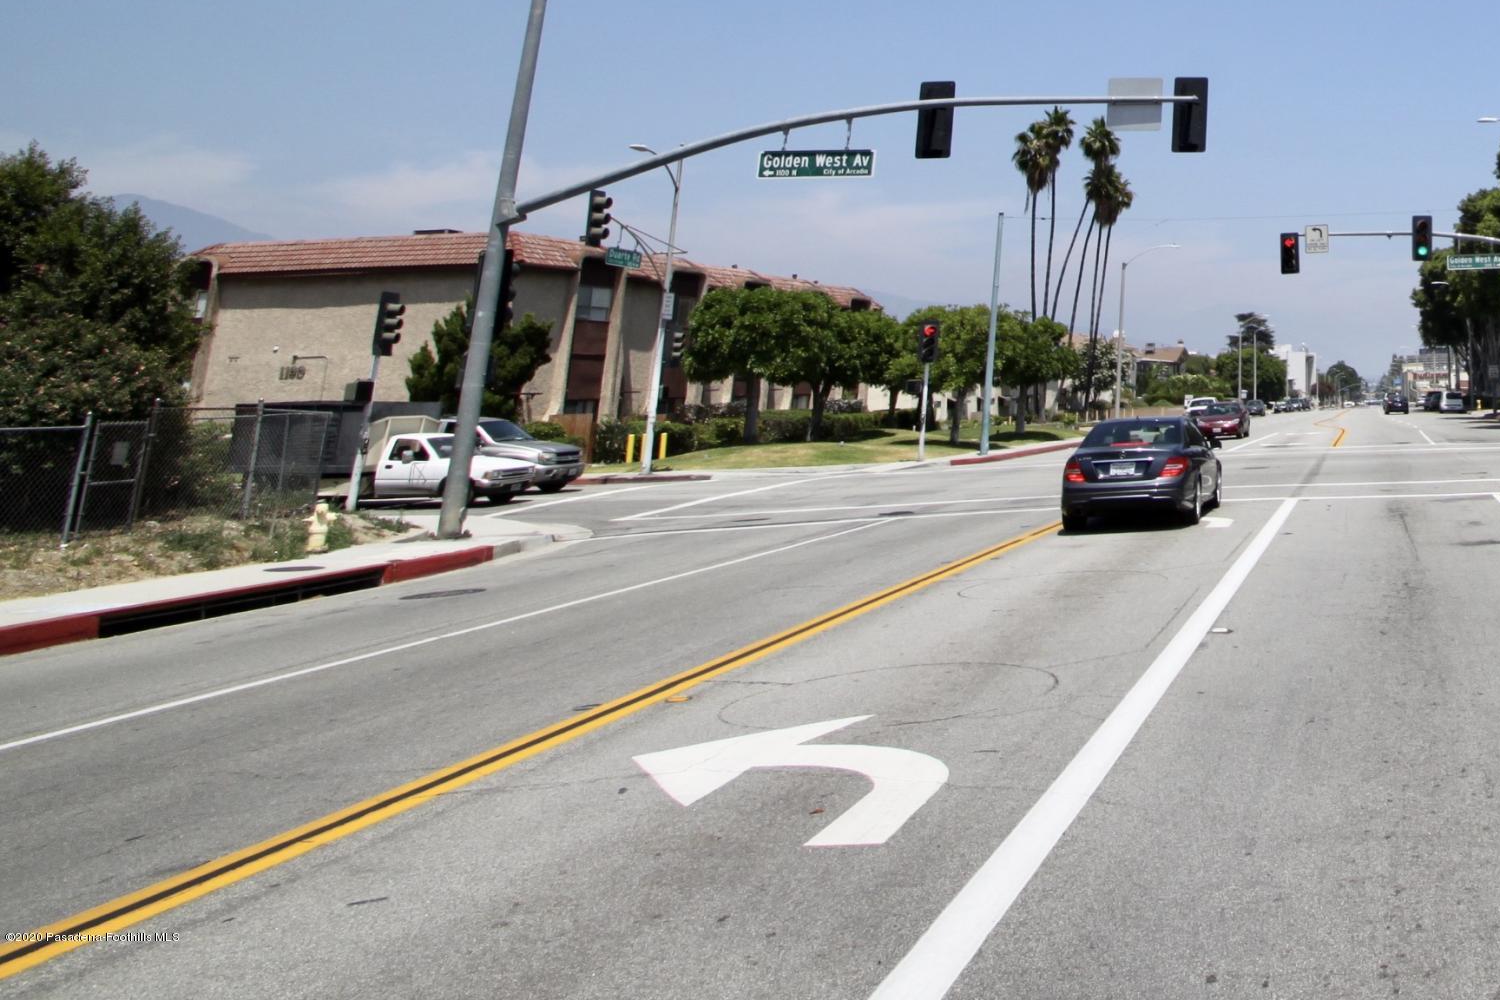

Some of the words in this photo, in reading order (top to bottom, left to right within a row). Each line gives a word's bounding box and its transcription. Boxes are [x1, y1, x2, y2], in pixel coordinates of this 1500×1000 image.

[763, 154, 809, 168] Golden
[815, 154, 848, 168] West
[853, 153, 870, 167] Av
[823, 168, 836, 176] City
[1474, 256, 1491, 264] West
